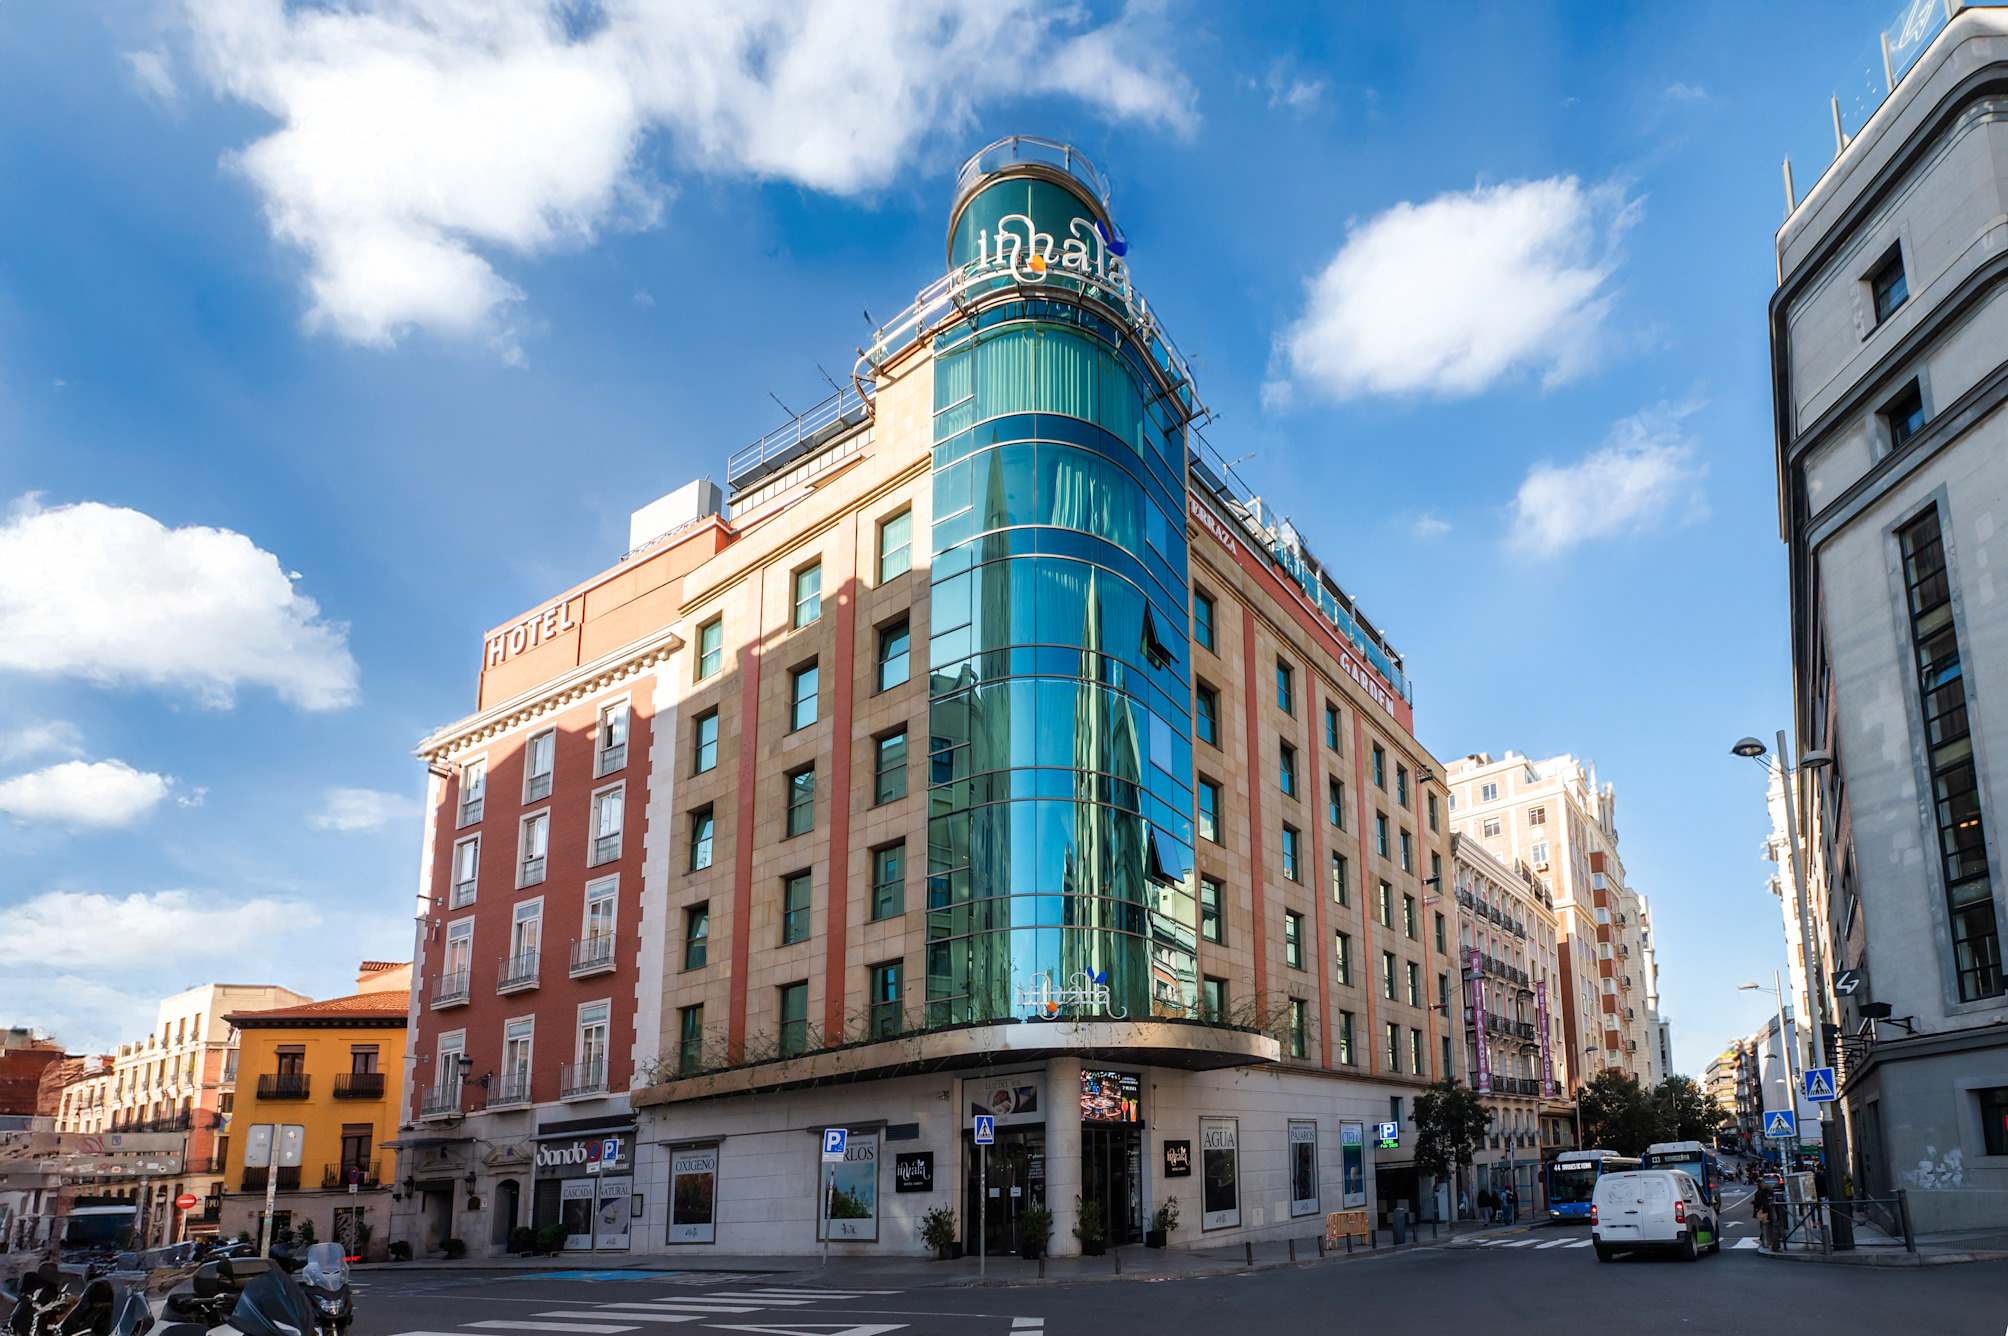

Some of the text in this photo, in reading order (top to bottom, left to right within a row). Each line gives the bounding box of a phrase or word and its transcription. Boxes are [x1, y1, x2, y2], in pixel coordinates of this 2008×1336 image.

[977, 213, 1140, 318] inhala
[1190, 499, 1394, 717] ERRAZA GARDEN
[488, 601, 574, 666] HOTEL
[1477, 1010, 1486, 1071] PALACE
[826, 1131, 841, 1151] P
[1203, 1131, 1235, 1147] AGUA
[604, 1142, 614, 1159] P
[675, 1158, 715, 1172] OXIGENO
[563, 1187, 592, 1198] CASCADA
